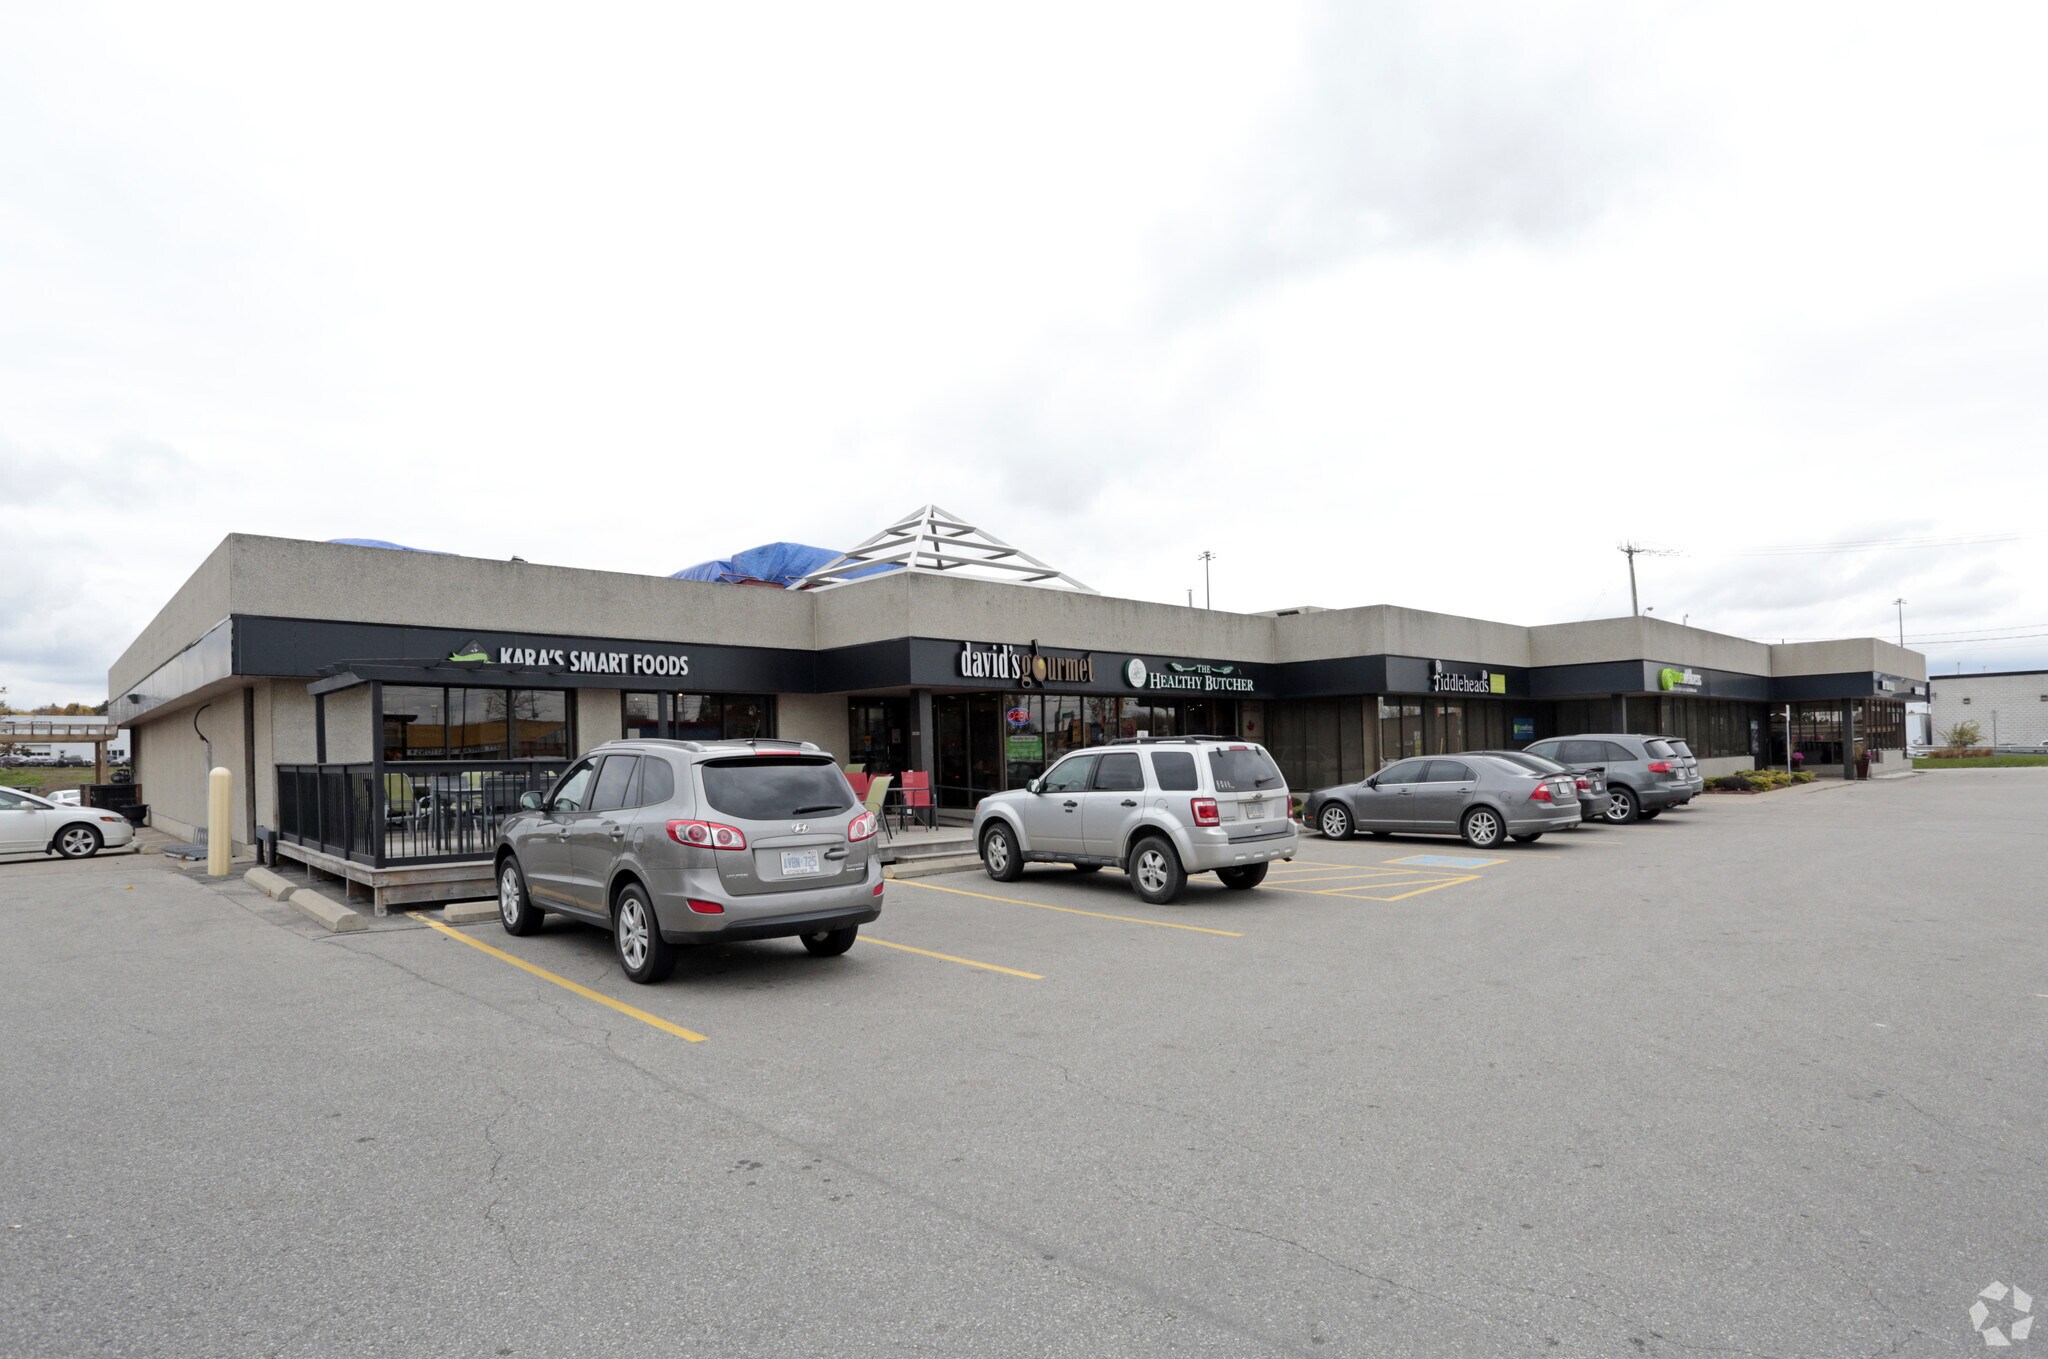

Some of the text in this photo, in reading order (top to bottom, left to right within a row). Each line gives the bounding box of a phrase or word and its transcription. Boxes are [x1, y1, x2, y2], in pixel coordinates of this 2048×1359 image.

[501, 647, 689, 675] KARA'S SMART FOODS
[961, 642, 1021, 679] david's
[1197, 664, 1211, 673] THE
[1149, 672, 1254, 691] HEALTHY BUTCHER
[1007, 710, 1031, 722] OPEN
